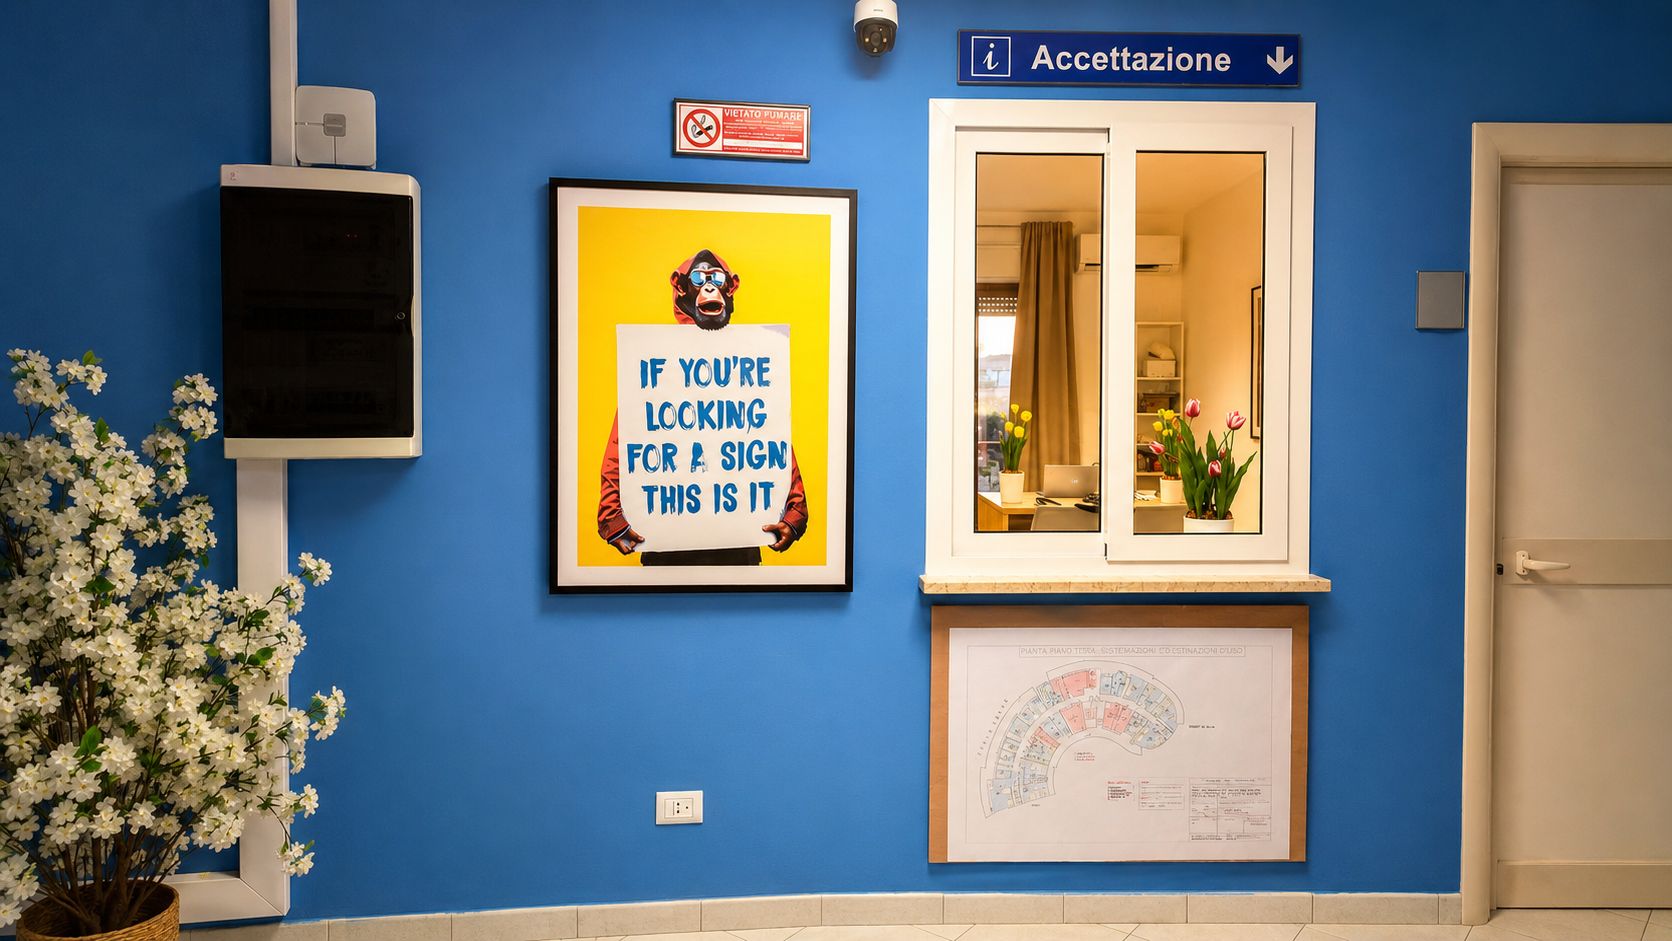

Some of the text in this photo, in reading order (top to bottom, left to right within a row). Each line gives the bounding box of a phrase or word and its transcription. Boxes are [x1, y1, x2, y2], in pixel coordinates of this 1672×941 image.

[1031, 44, 1232, 72] Accettazione
[724, 108, 761, 119] VIETATO
[640, 355, 771, 389] IF YOU'RE
[645, 398, 768, 434] LOOKING
[626, 439, 788, 474] FOR A SIGN
[641, 481, 775, 516] THIS IS IT
[1020, 647, 1048, 655] PIANTA
